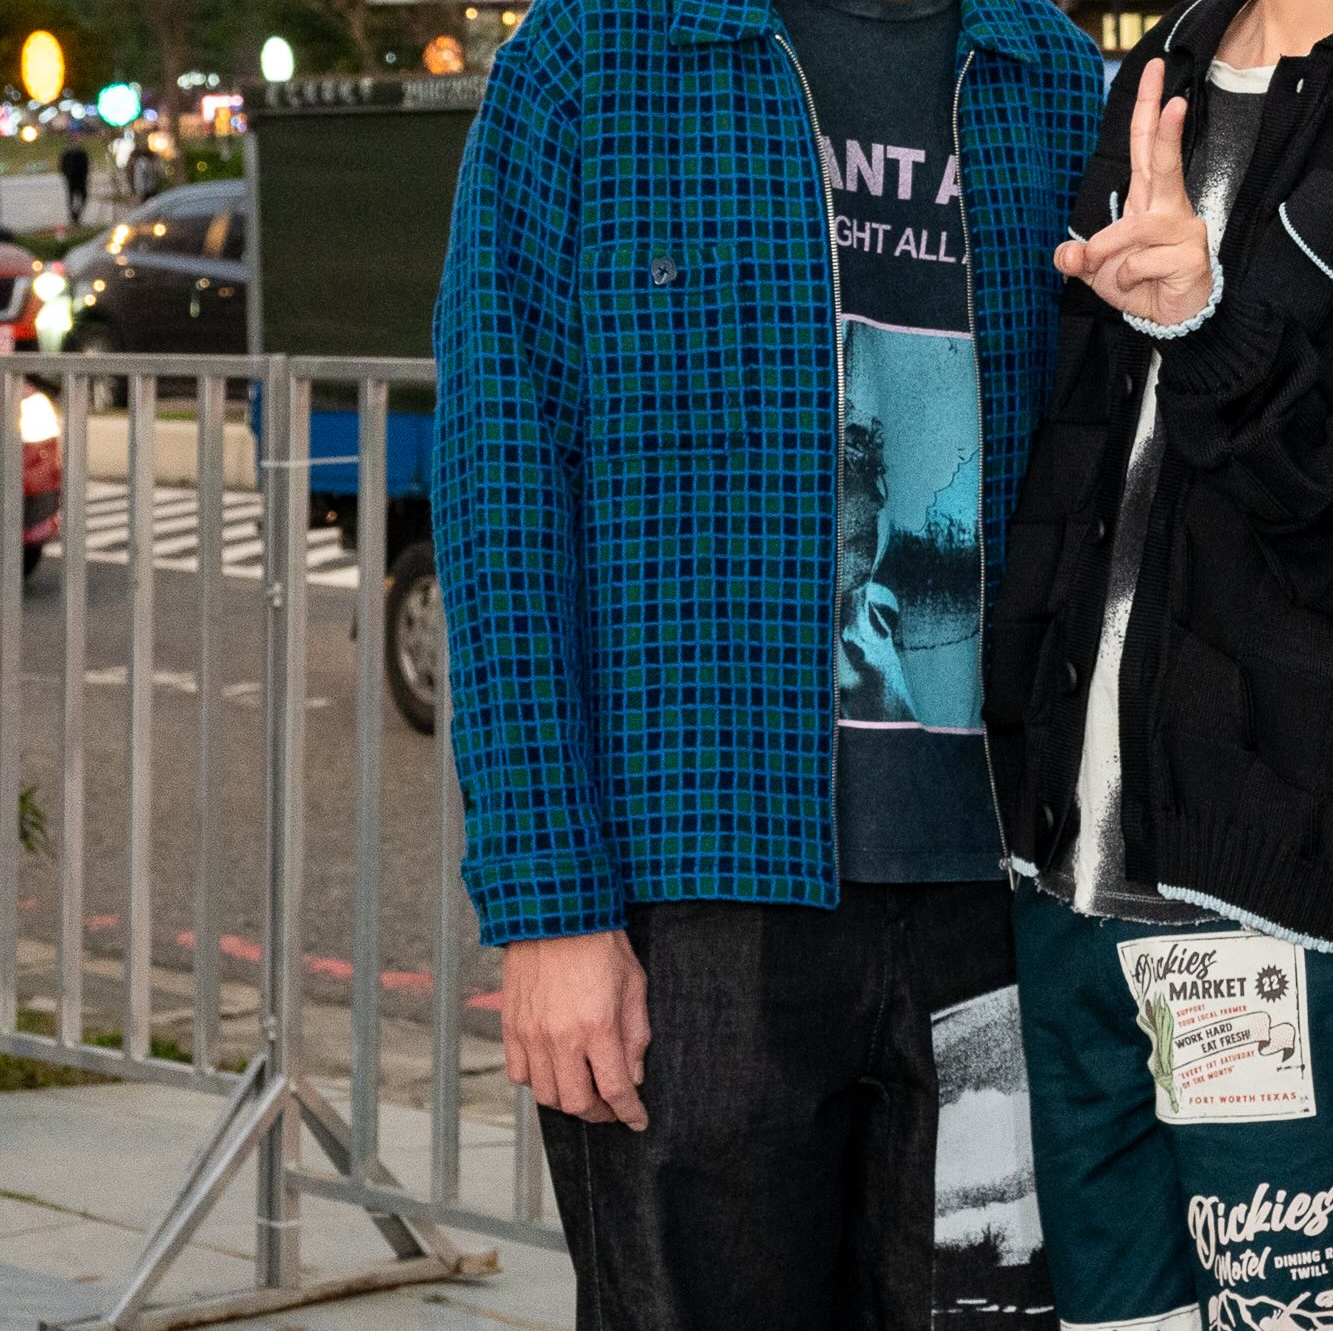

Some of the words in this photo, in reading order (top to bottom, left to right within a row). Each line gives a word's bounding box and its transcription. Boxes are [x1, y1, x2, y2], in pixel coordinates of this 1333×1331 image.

[834, 215, 891, 254] GHT
[894, 227, 957, 263] ALL
[1132, 943, 1218, 1001] Dickies
[1169, 977, 1247, 1001] MARKET
[1176, 1004, 1206, 1018] SUPPORT
[1197, 1010, 1218, 1022] LOCAL
[1220, 1005, 1248, 1016] FARMER
[1175, 1032, 1204, 1049] WORK
[1205, 1022, 1233, 1039] HARD
[1201, 1041, 1220, 1053] EAT
[1221, 1029, 1251, 1048] FRESH!
[1220, 1050, 1256, 1065] SATURDAY
[1193, 1075, 1205, 1085] THE
[1189, 1096, 1215, 1105] FORT
[1219, 1095, 1256, 1104] WORTH
[1260, 1092, 1297, 1102] TEXAS
[1215, 1246, 1272, 1287] Motel
[1274, 1250, 1321, 1269] DINING
[1290, 1263, 1329, 1281] TWILL
